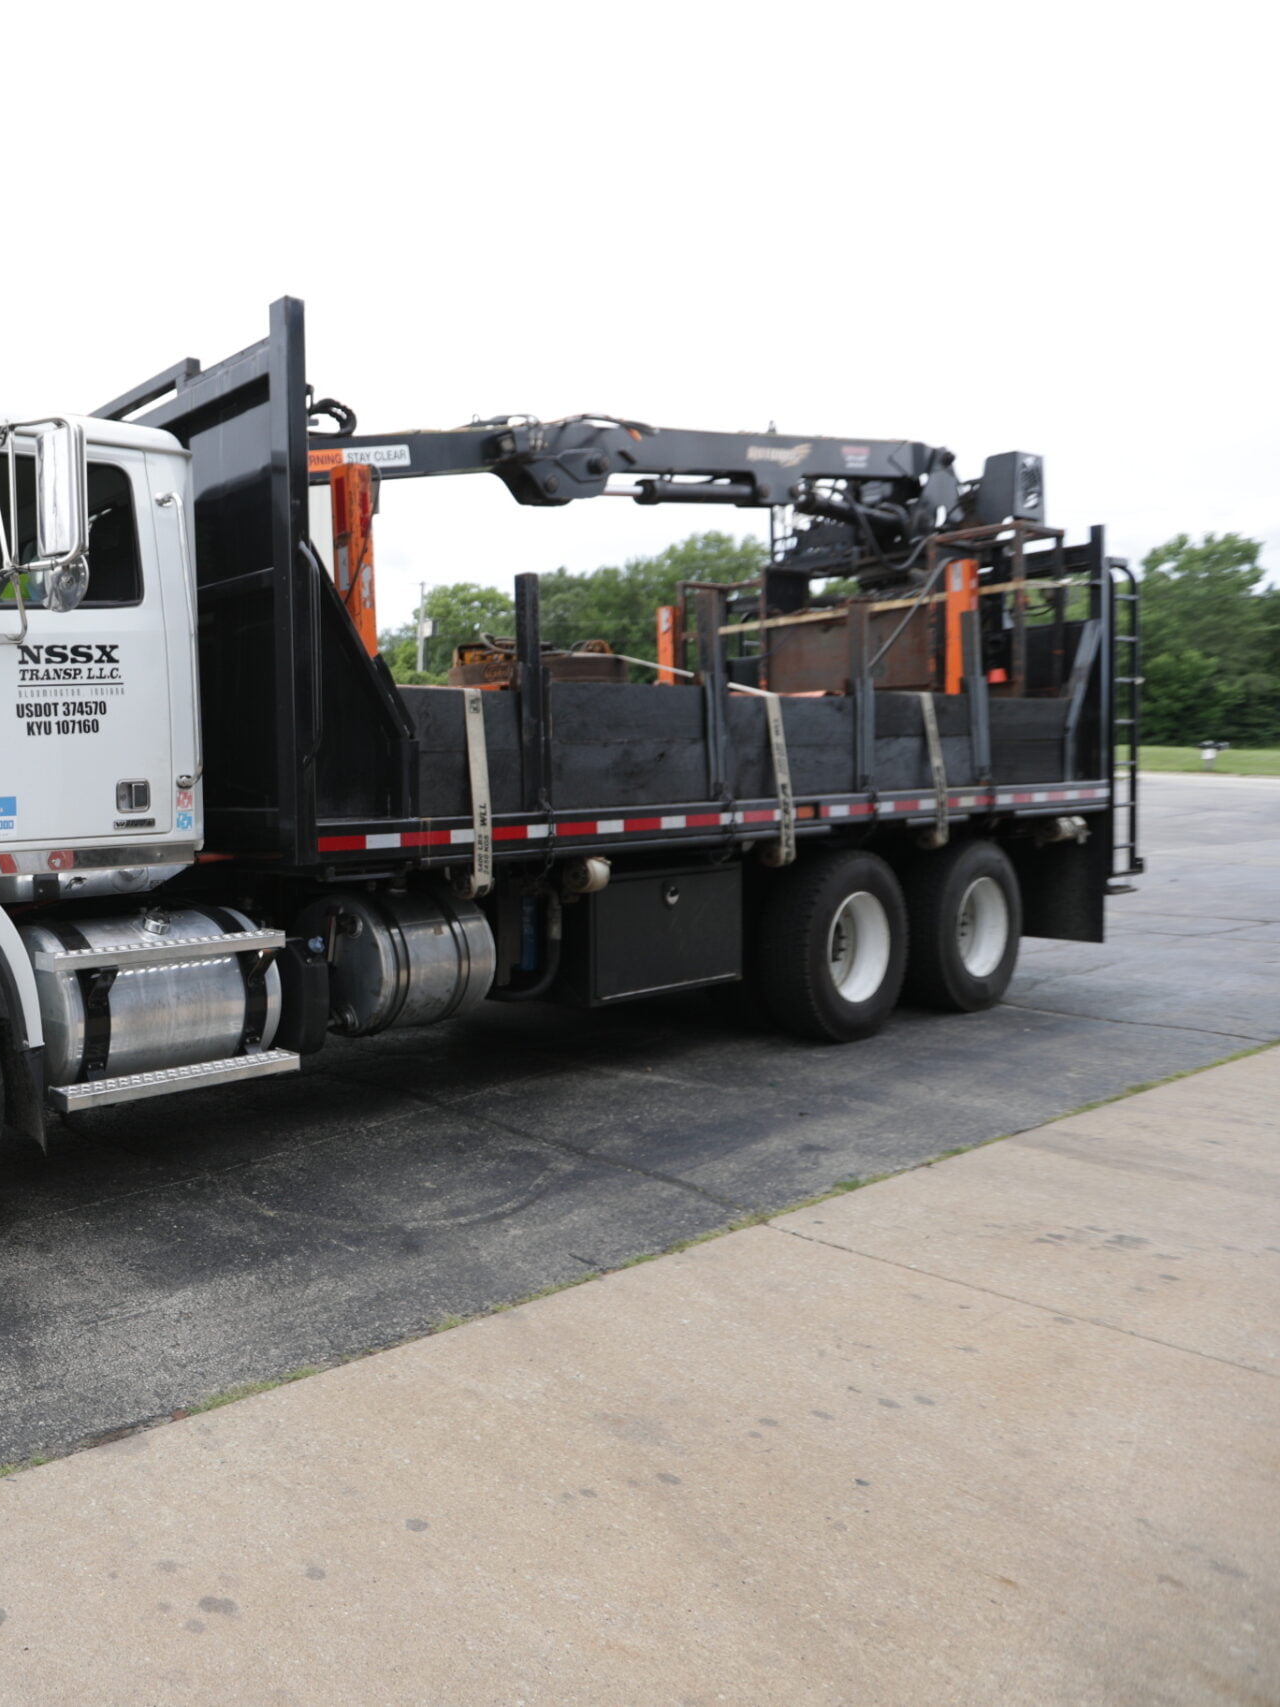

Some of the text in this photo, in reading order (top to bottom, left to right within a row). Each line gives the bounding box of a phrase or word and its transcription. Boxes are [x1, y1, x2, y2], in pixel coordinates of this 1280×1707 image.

[309, 449, 407, 465] RNING STAY CLEAR
[17, 644, 120, 665] NSSX
[19, 668, 83, 681] TRANSP.
[16, 701, 107, 719] USDOT 374570
[26, 719, 99, 736] KYU 107160
